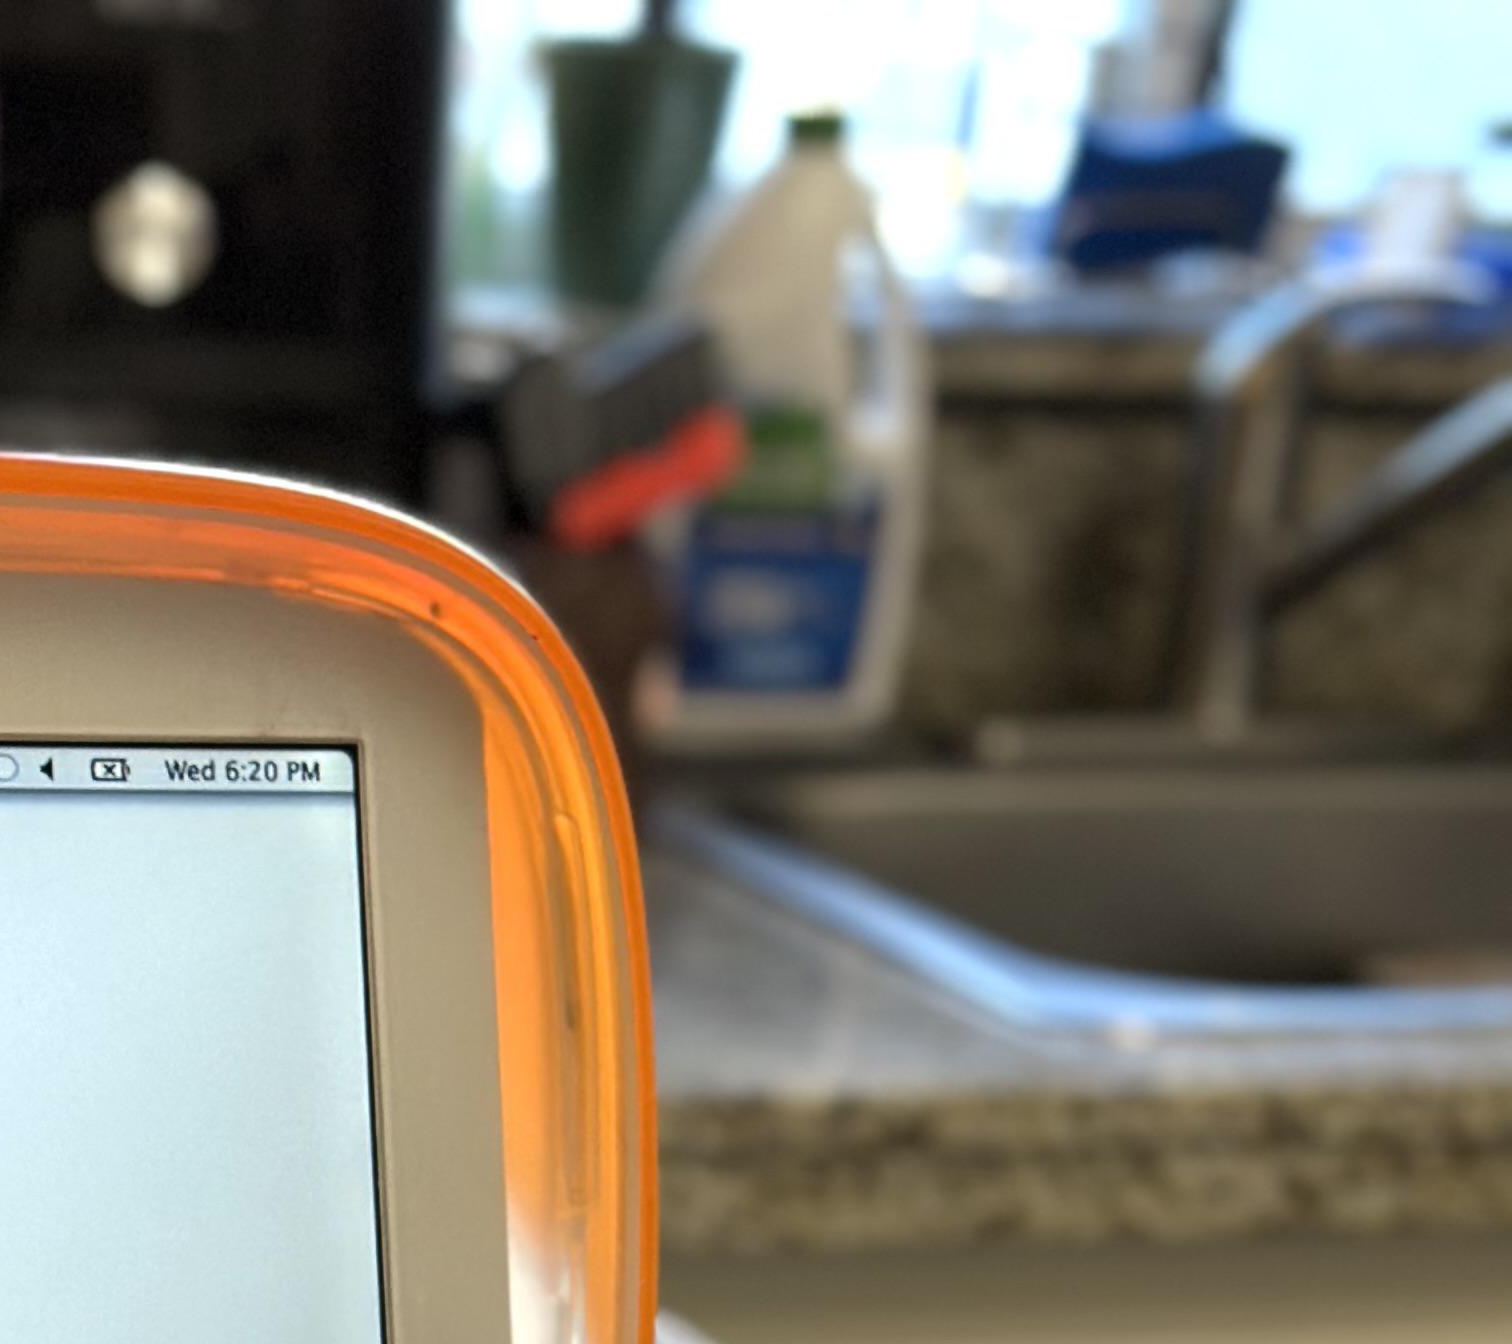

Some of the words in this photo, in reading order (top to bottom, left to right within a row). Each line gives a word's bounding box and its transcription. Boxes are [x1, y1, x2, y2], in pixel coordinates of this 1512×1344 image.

[164, 758, 215, 782] Wed
[225, 760, 278, 782] 6:20
[287, 761, 321, 782] PM
